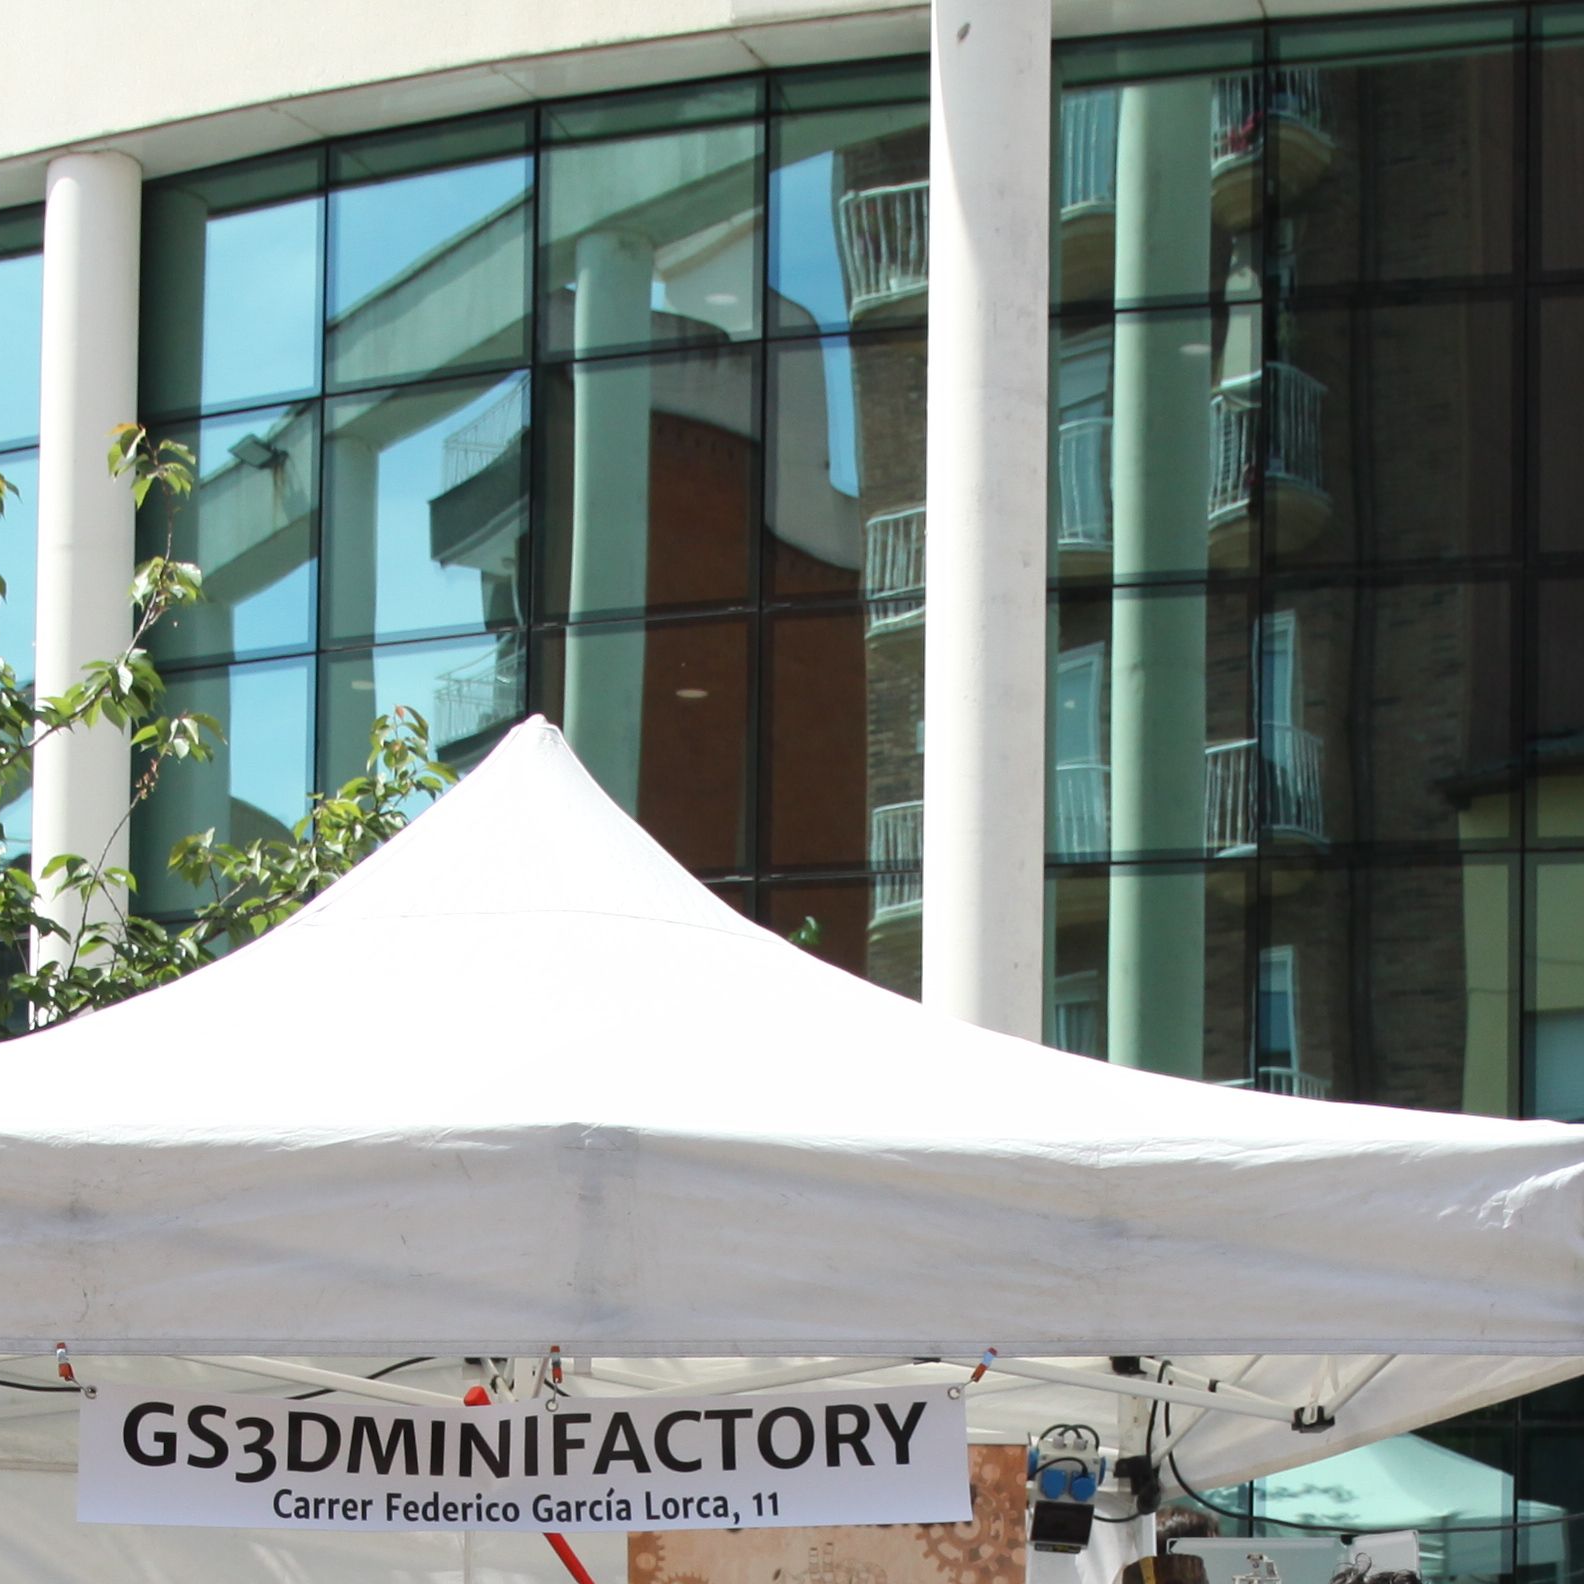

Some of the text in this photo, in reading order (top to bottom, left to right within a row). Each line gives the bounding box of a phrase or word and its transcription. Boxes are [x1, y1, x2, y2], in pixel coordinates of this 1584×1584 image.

[121, 1400, 928, 1483] GS3DMINIFACTORY
[273, 1487, 780, 1525] Carrer Federico García Lorca, 11
